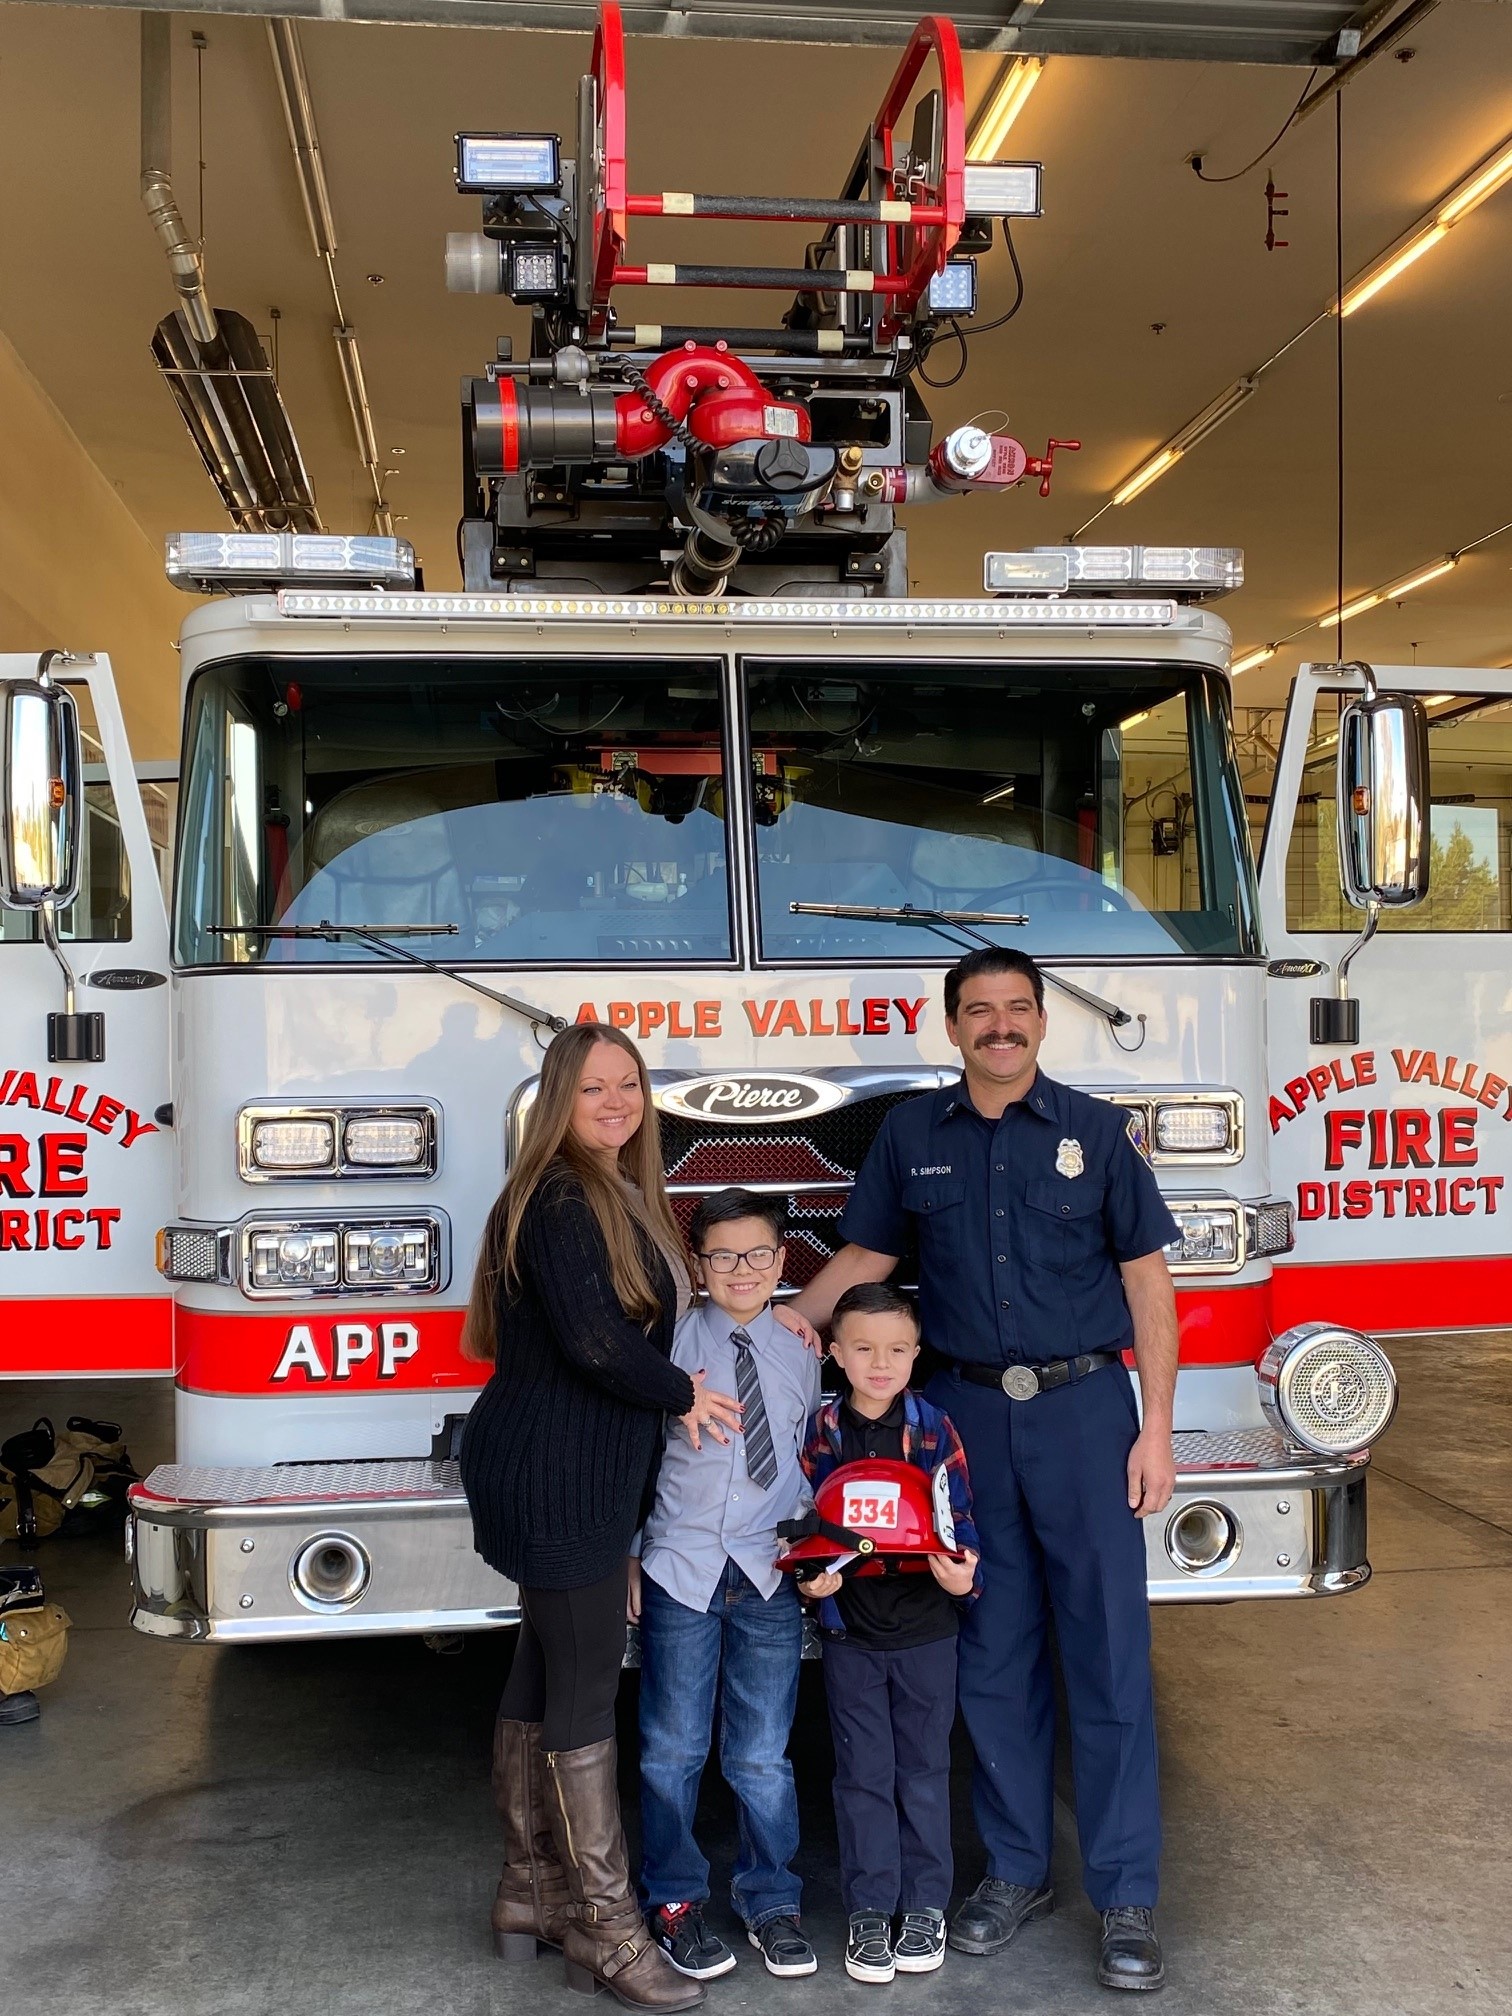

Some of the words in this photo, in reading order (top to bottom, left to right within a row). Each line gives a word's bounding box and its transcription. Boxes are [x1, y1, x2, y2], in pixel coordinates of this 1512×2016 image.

[574, 1000, 722, 1039] APPLE
[741, 997, 930, 1037] VALLEY
[702, 1081, 803, 1113] Pierce
[1267, 1051, 1377, 1135] APPLE
[1390, 1048, 1512, 1122] VALLE
[1324, 1107, 1479, 1171] FIRE
[920, 1165, 952, 1176] SIMPSON
[1296, 1176, 1505, 1221] DISTRICT
[269, 1323, 419, 1382] APP
[848, 1498, 896, 1525] 334
